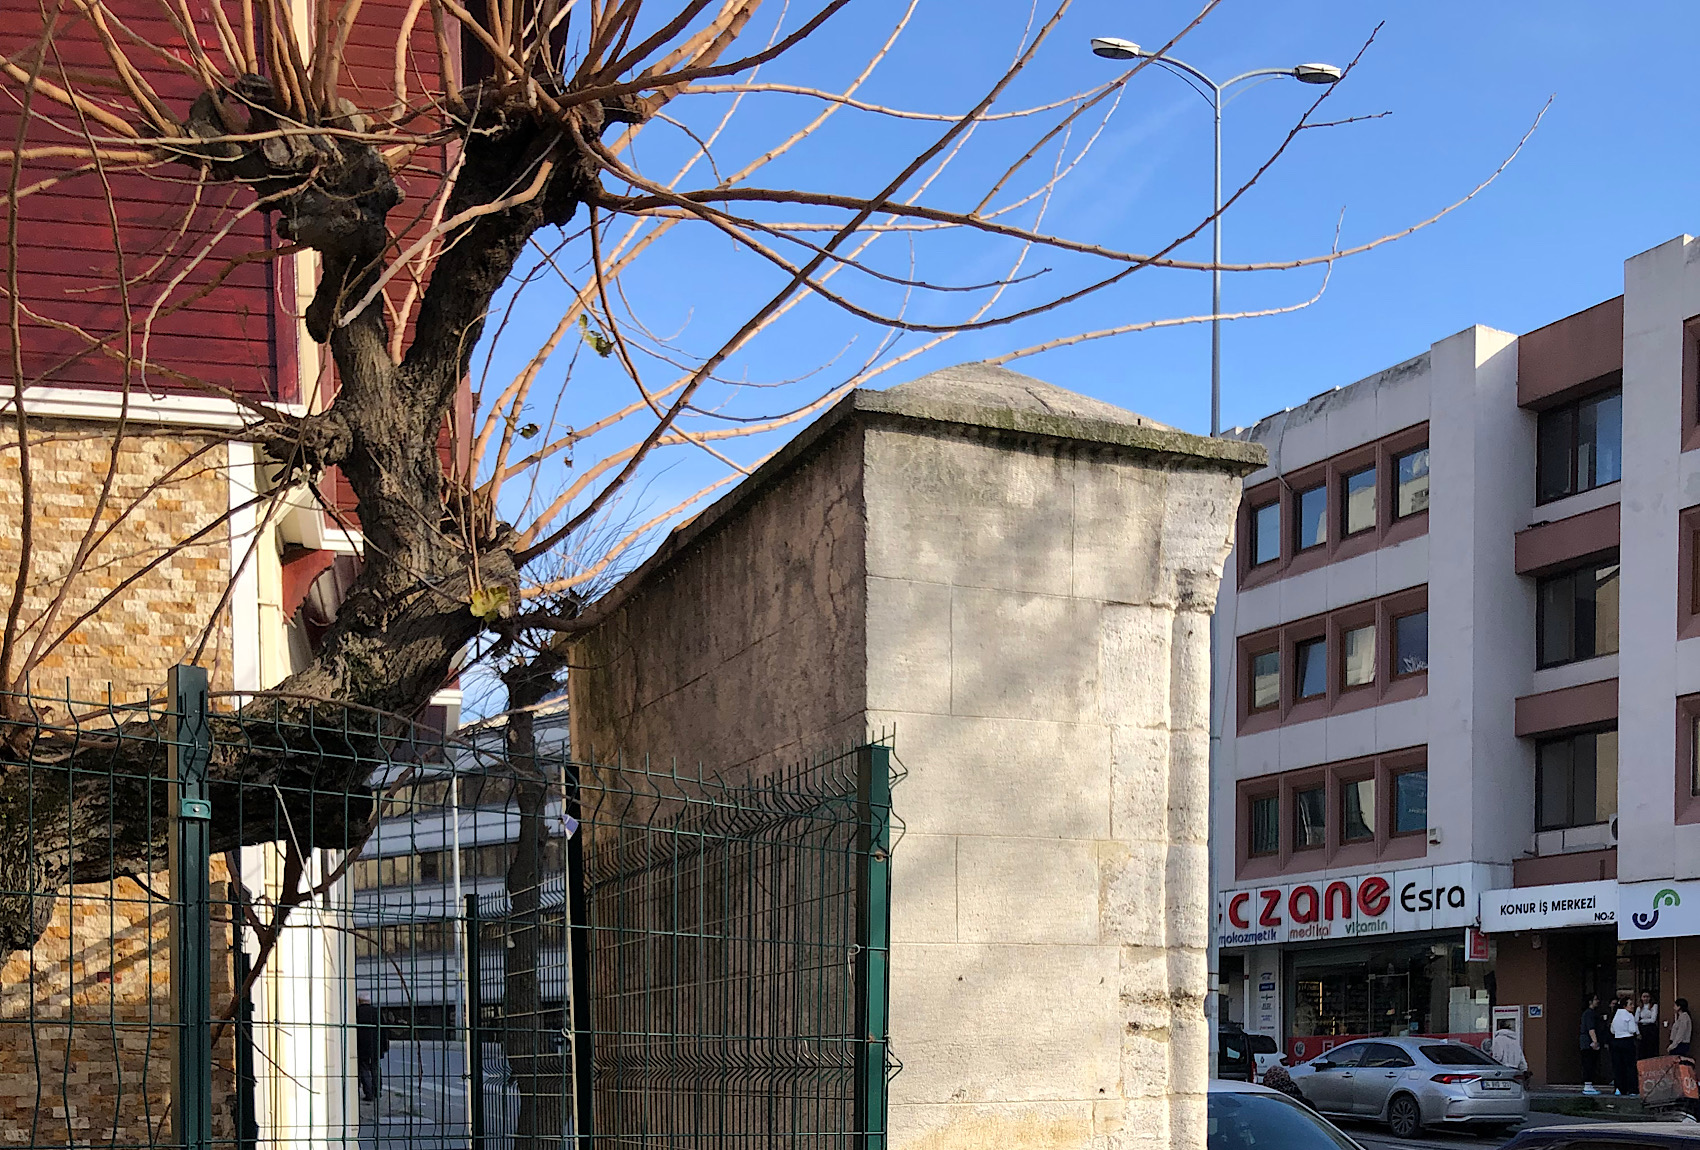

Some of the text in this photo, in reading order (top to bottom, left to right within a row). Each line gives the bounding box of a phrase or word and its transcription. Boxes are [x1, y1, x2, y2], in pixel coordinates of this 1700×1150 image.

[1219, 876, 1465, 929] czane Esra
[1500, 895, 1596, 916] KONUR İŞ MERKEZİ
[1289, 923, 1332, 939] medikal
[1345, 919, 1388, 934] vitamin
